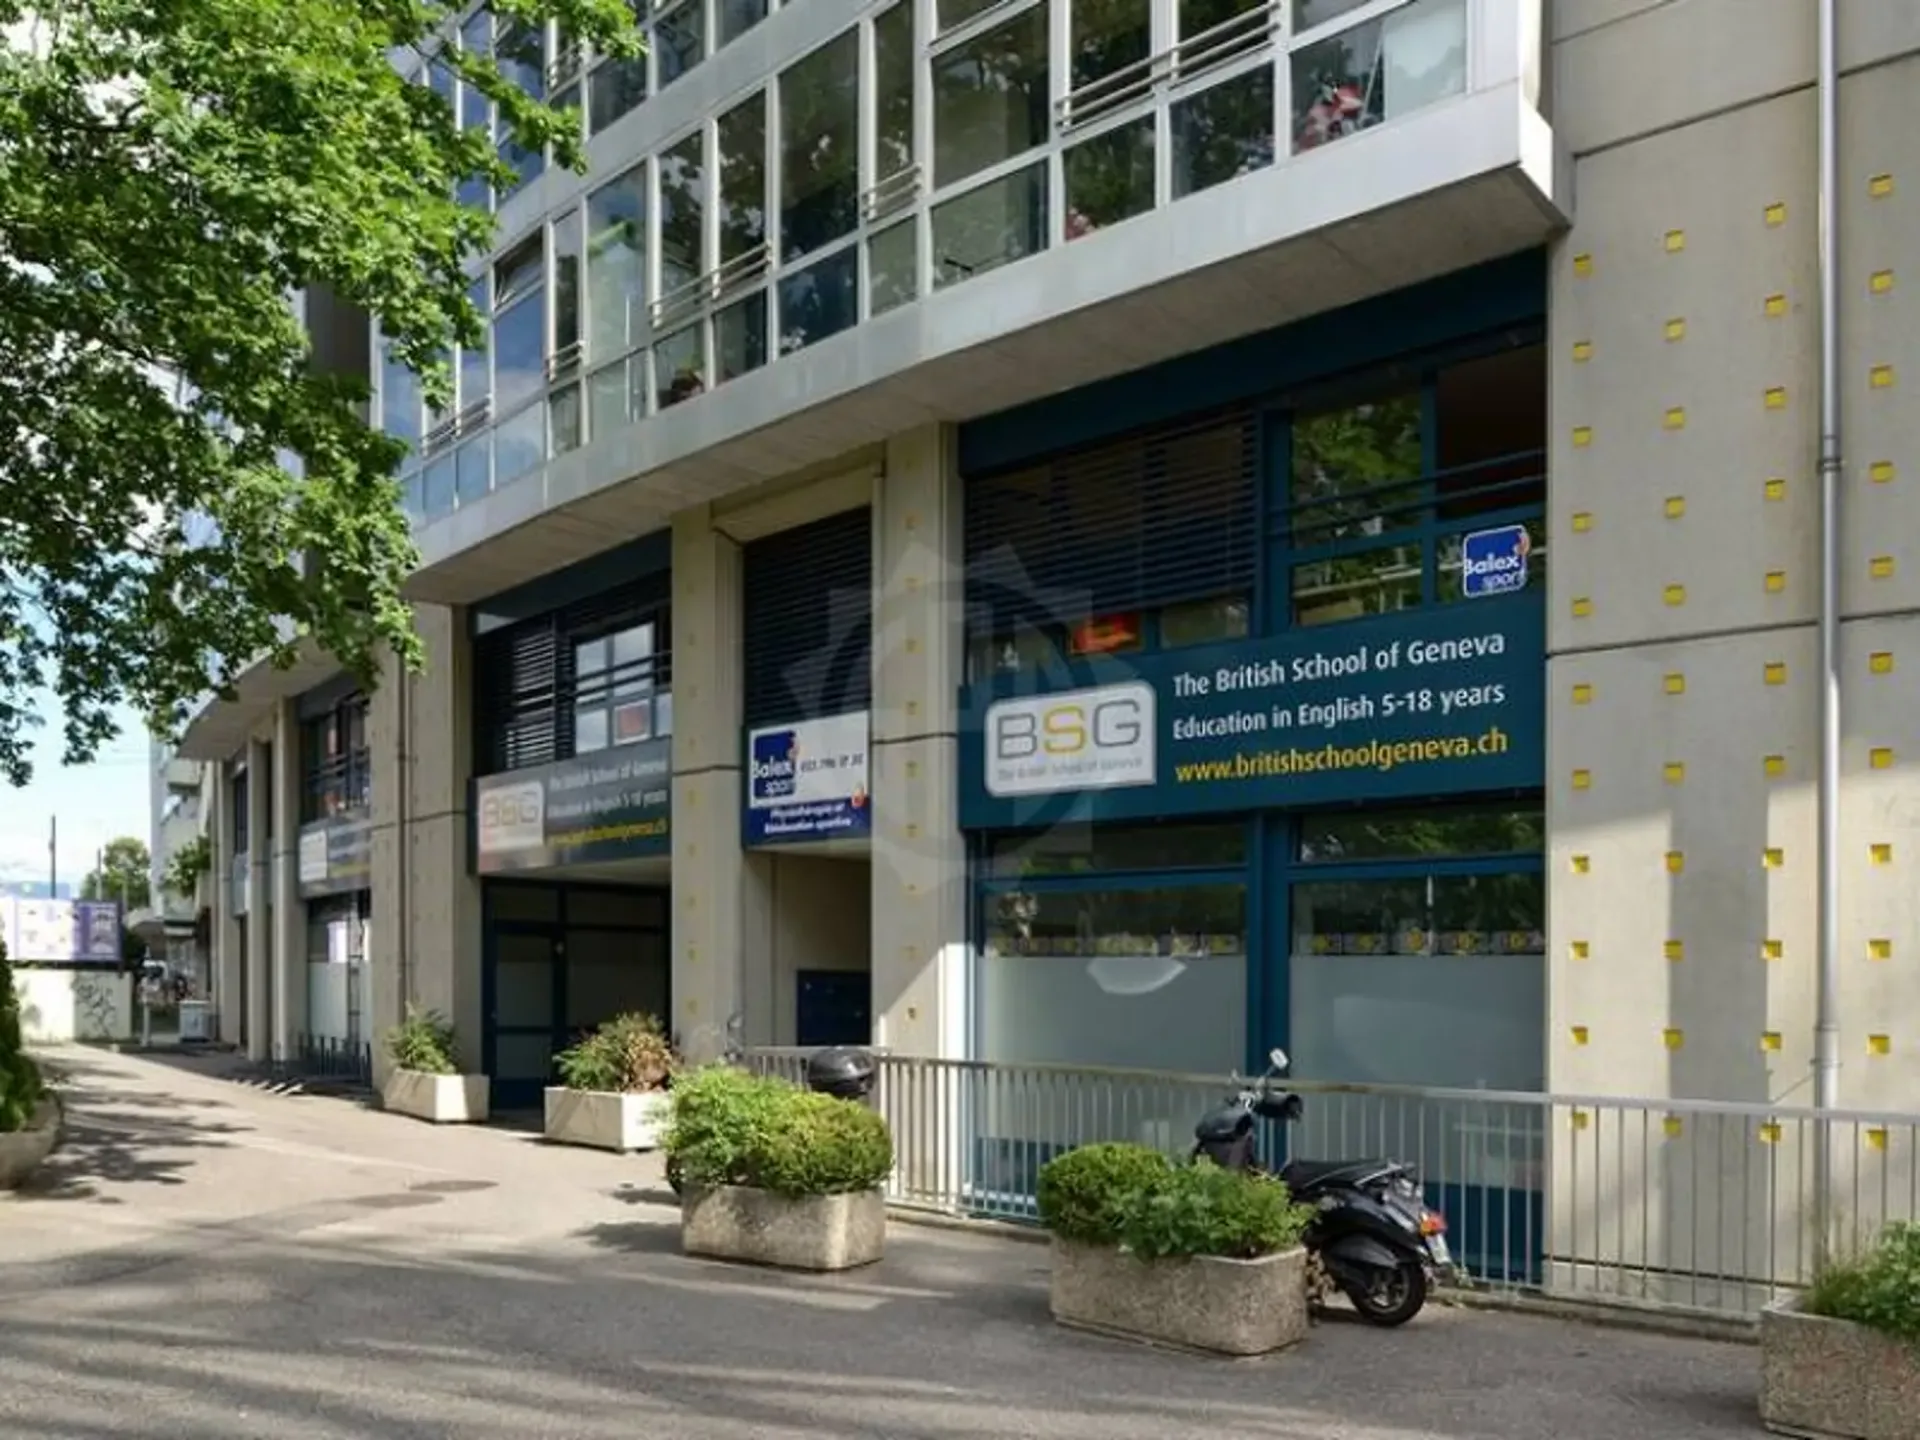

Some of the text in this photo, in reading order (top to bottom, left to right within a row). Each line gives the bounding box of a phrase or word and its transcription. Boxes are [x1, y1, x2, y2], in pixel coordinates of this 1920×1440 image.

[1173, 633, 1505, 697] The British School of Geneva
[998, 698, 1140, 759] BSG
[1173, 684, 1505, 740] Education in English 5-18 years
[1175, 725, 1508, 782] www.britishschoolgeneva.ch
